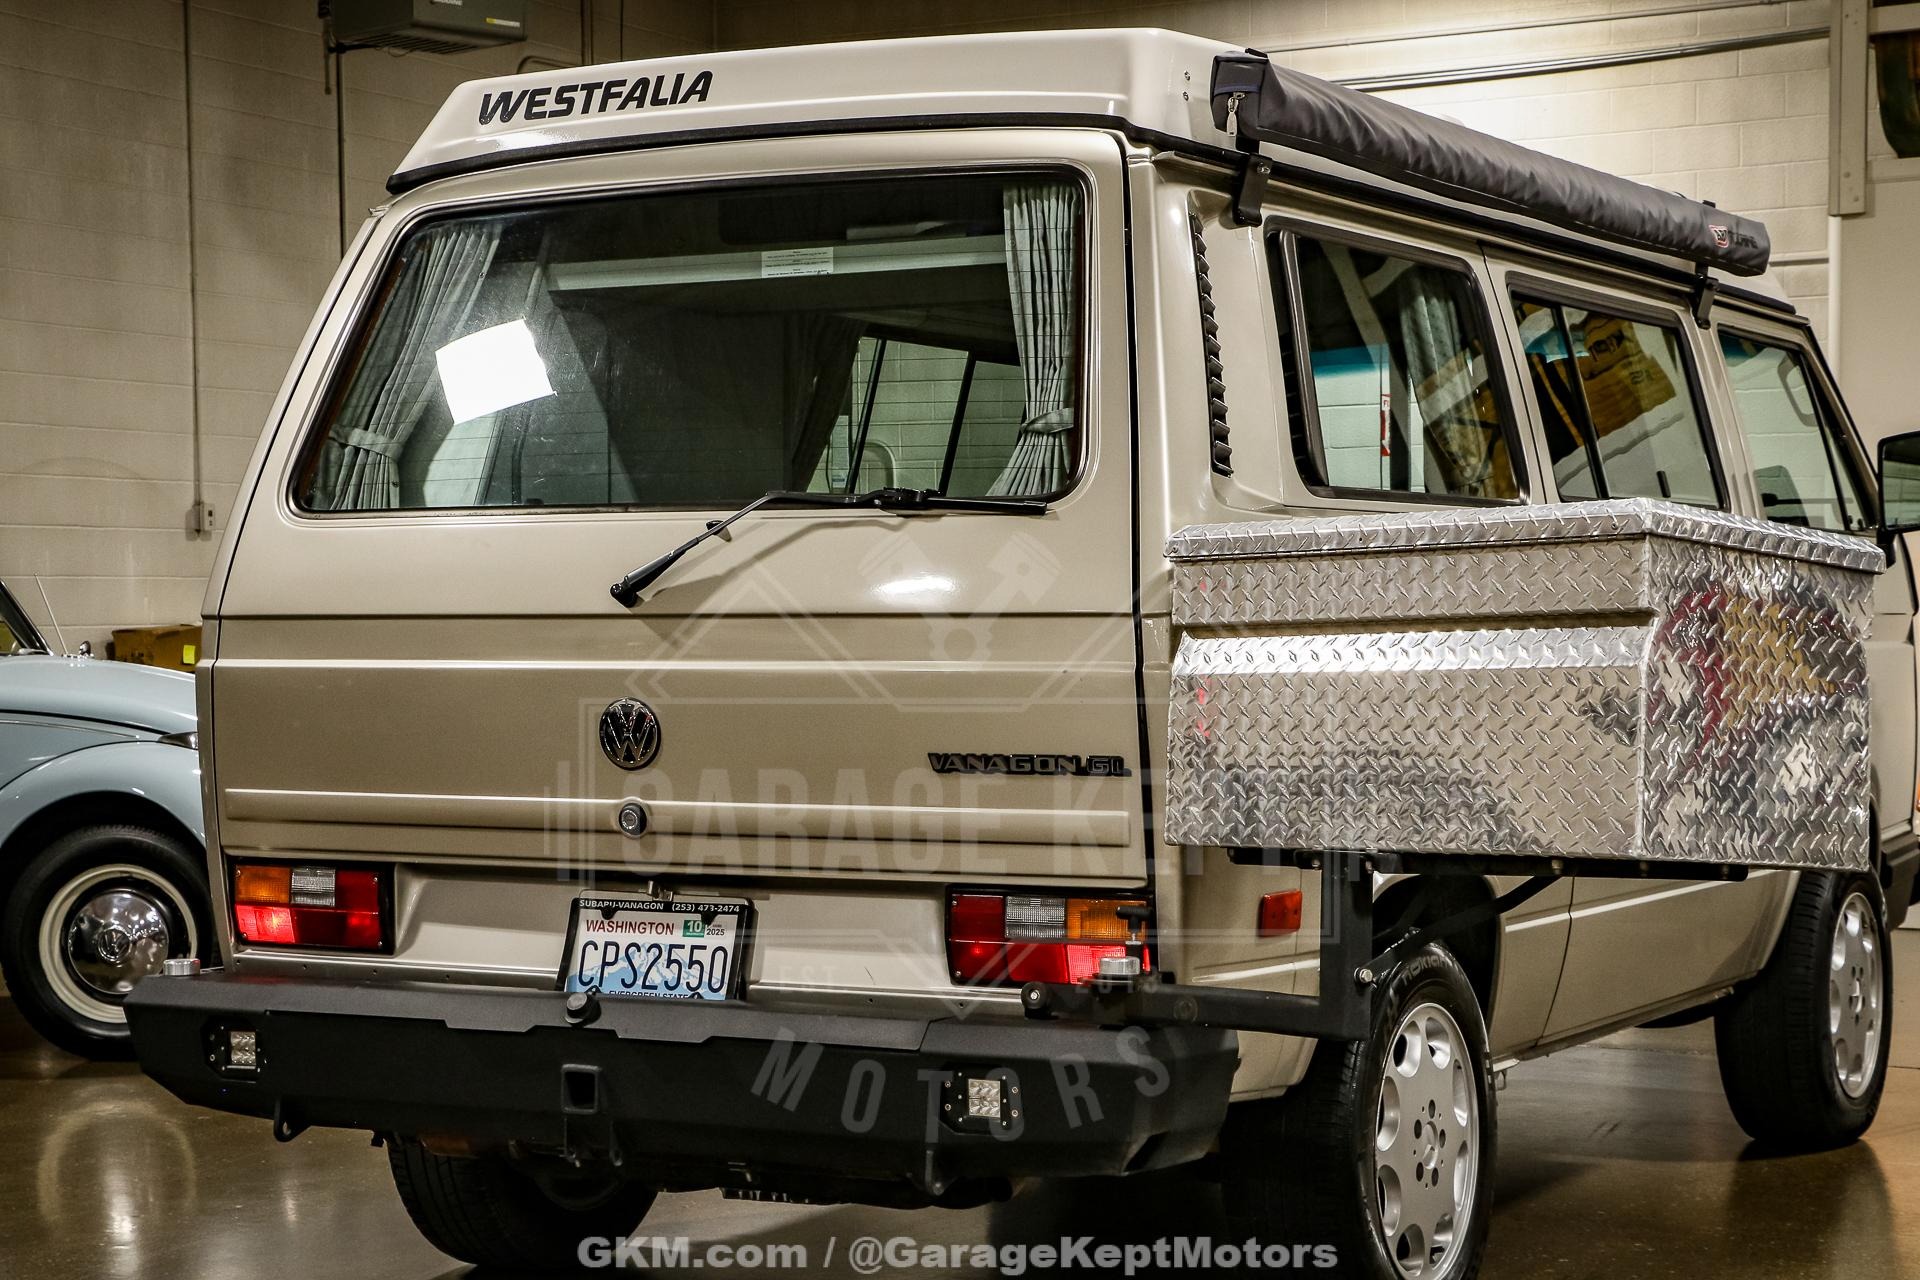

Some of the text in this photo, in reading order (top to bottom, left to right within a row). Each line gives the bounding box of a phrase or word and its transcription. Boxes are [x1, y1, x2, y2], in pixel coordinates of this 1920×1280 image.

[478, 70, 713, 125] WESTFALIA
[928, 753, 1081, 776] VANAGON
[671, 903, 695, 912] (253)
[697, 903, 740, 913] 473-2474
[586, 919, 675, 936] WASHINGTON
[687, 920, 702, 933] 10
[706, 928, 725, 936] 2025
[578, 940, 728, 994] CPS2550
